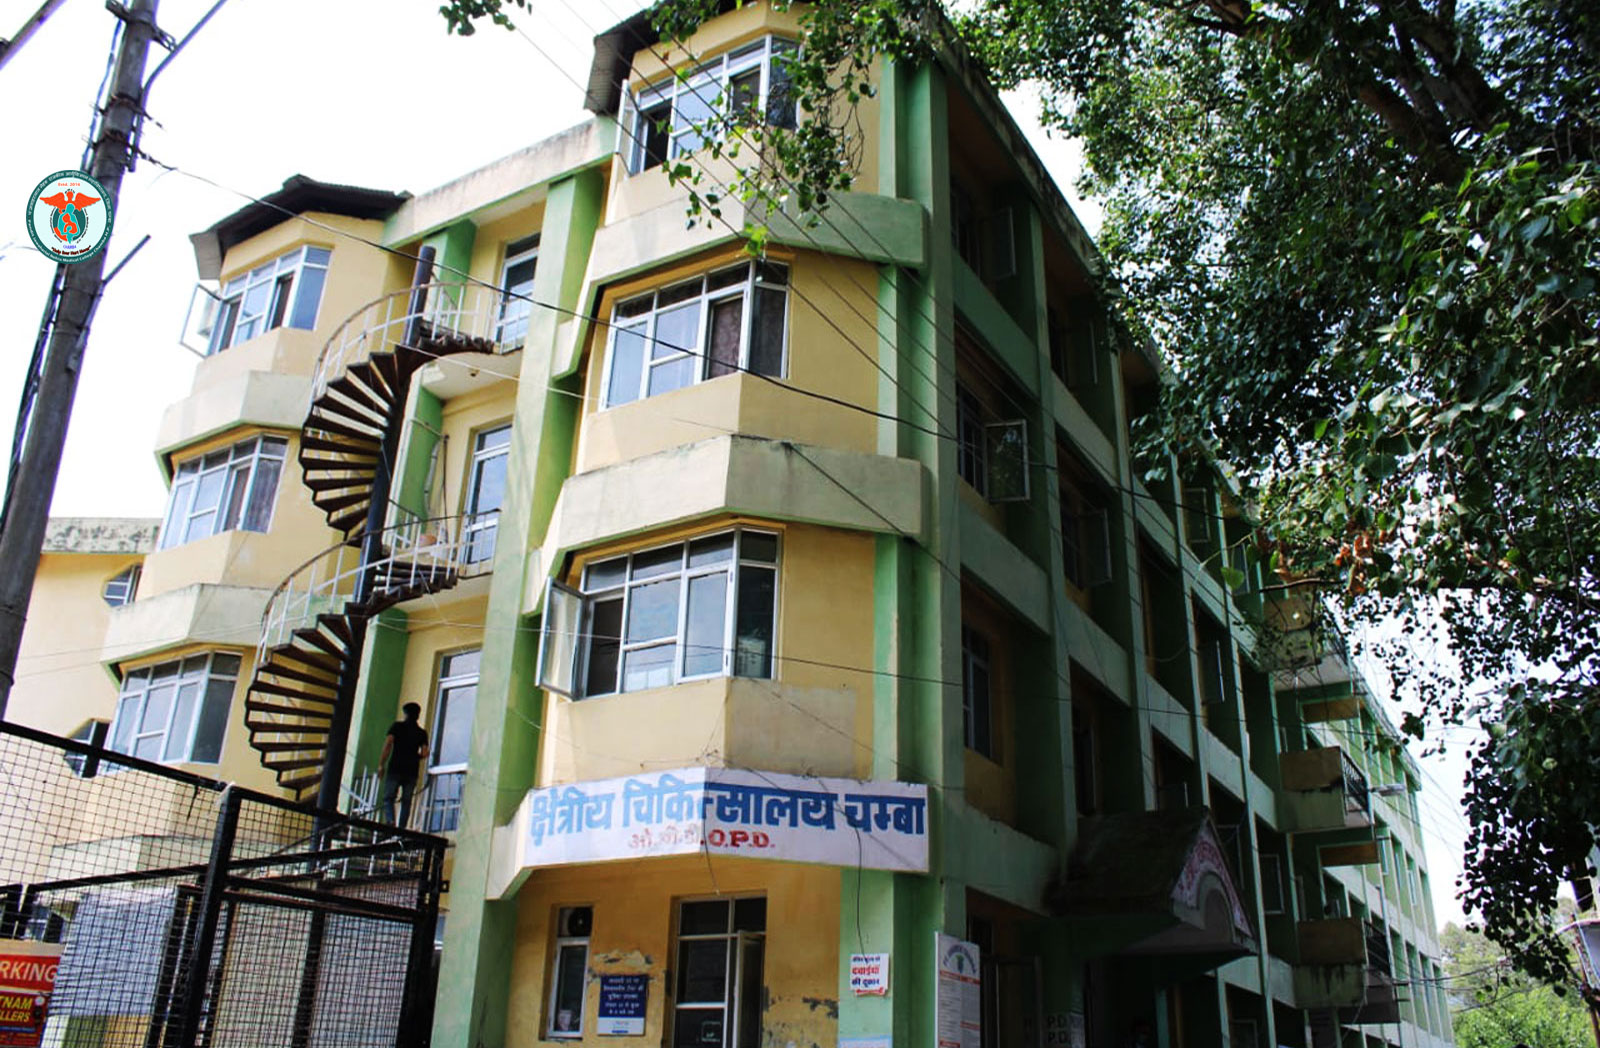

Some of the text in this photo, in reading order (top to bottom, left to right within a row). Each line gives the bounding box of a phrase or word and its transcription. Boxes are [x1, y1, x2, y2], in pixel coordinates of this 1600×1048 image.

[531, 774, 926, 846] क्षेत्रीय चिकित्सालय चम्बा
